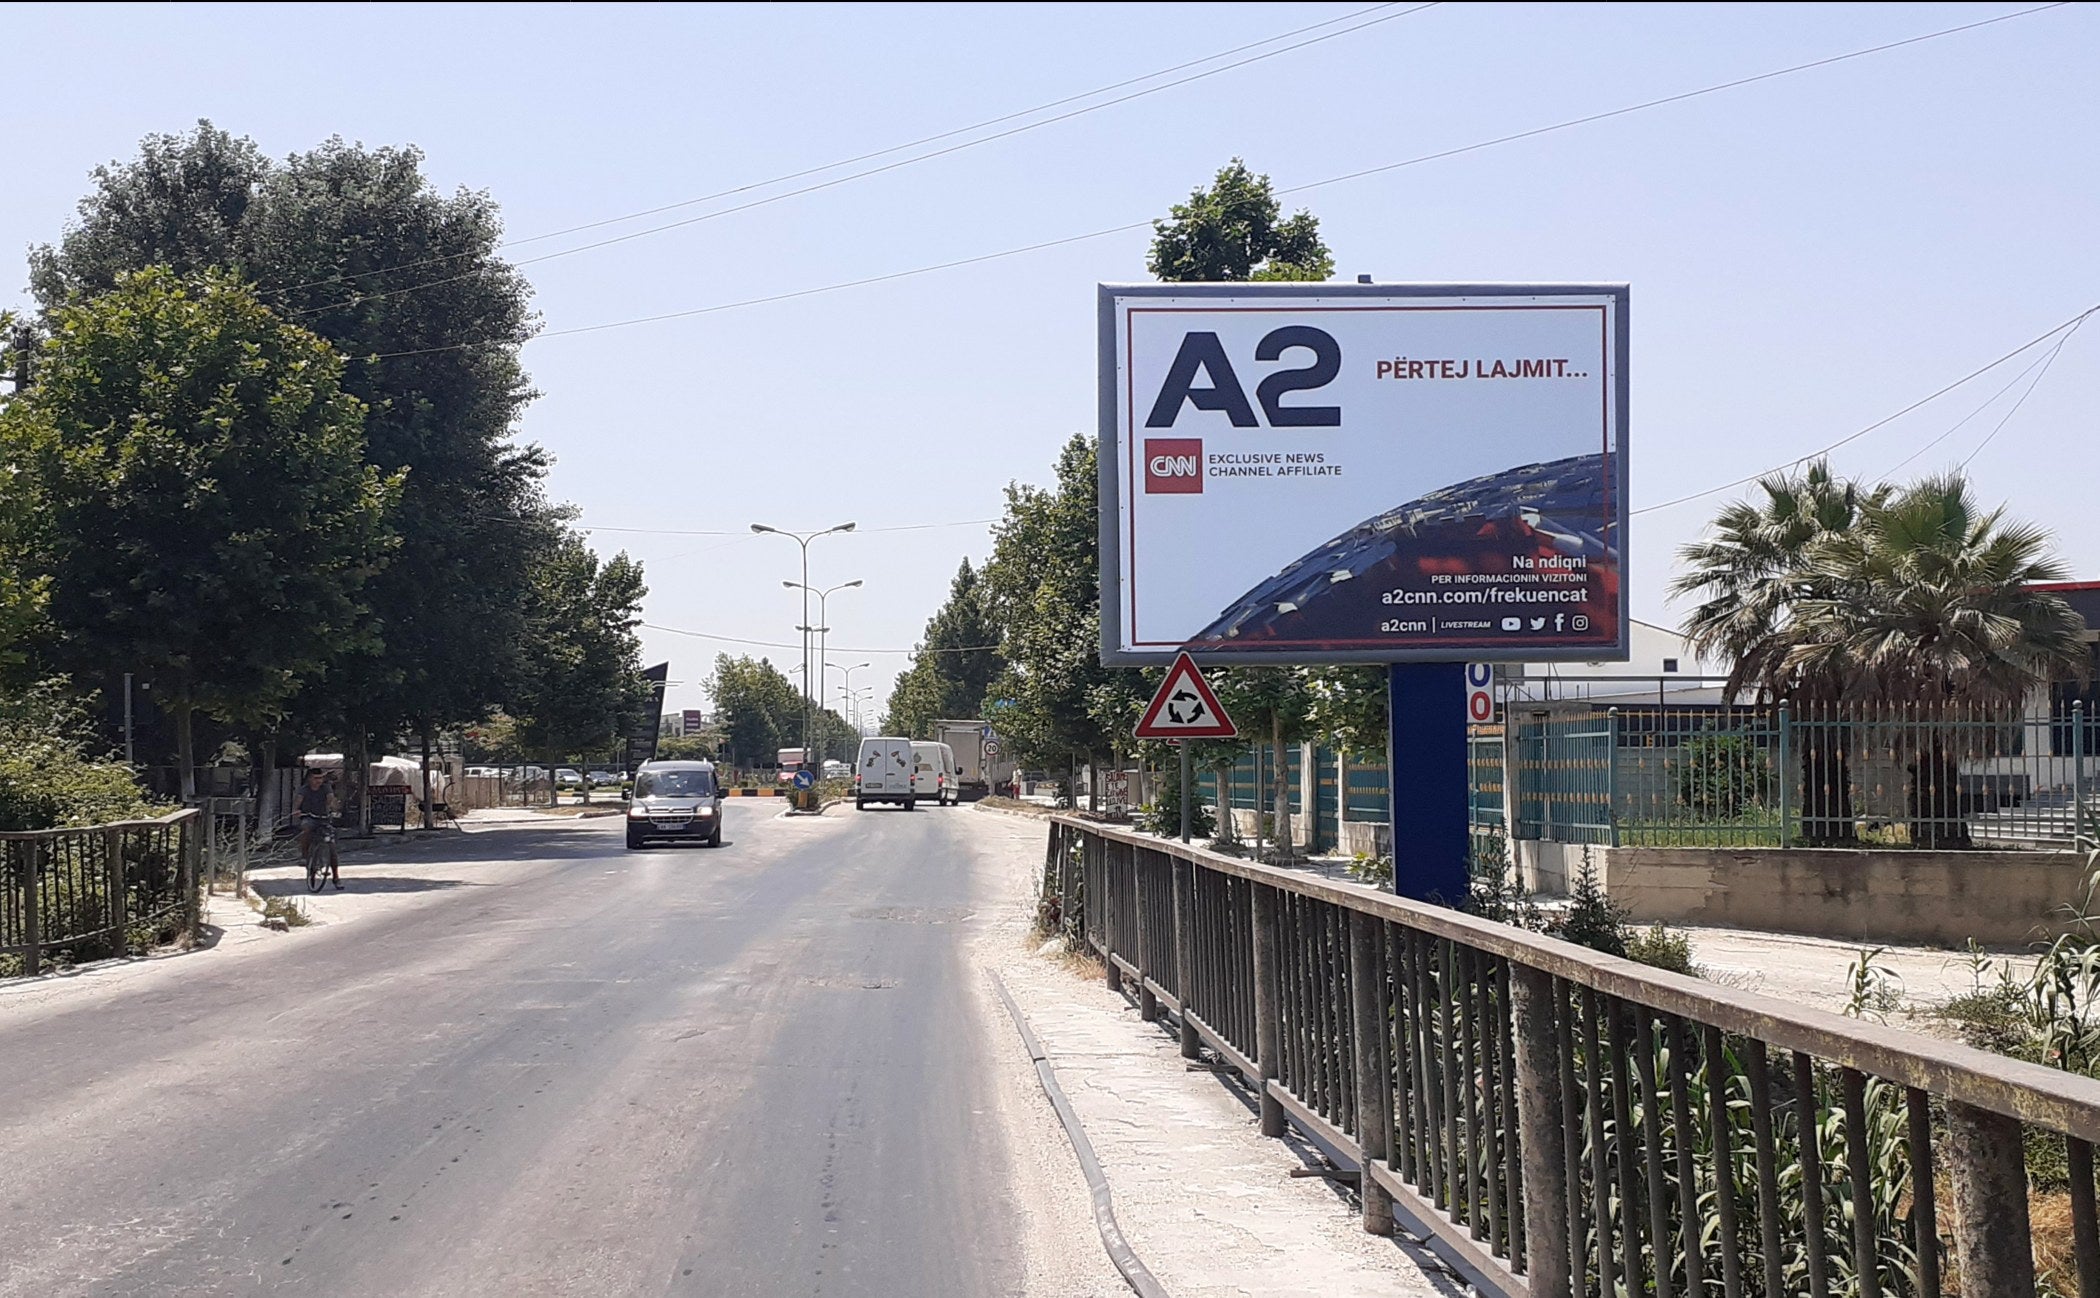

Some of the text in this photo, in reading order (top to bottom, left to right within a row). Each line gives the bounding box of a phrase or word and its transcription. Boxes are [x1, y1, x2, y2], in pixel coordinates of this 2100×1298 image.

[1376, 356, 1588, 379] PËRTEJ LAJMIT...
[1145, 325, 1342, 428] A2
[1150, 455, 1197, 477] CNN
[1209, 453, 1325, 464] EXCLUSIVE NEWS
[1209, 465, 1342, 477] CHANNEL AFFILIATE
[1512, 554, 1587, 571] Na ndiqni
[1431, 573, 1587, 584] PER INFORMACIONIN VIZITONI
[1381, 587, 1588, 605] a2cnn.com/frekuencat
[1381, 618, 1491, 632] a2cnn LIVESTREAM
[988, 744, 997, 752] 20
